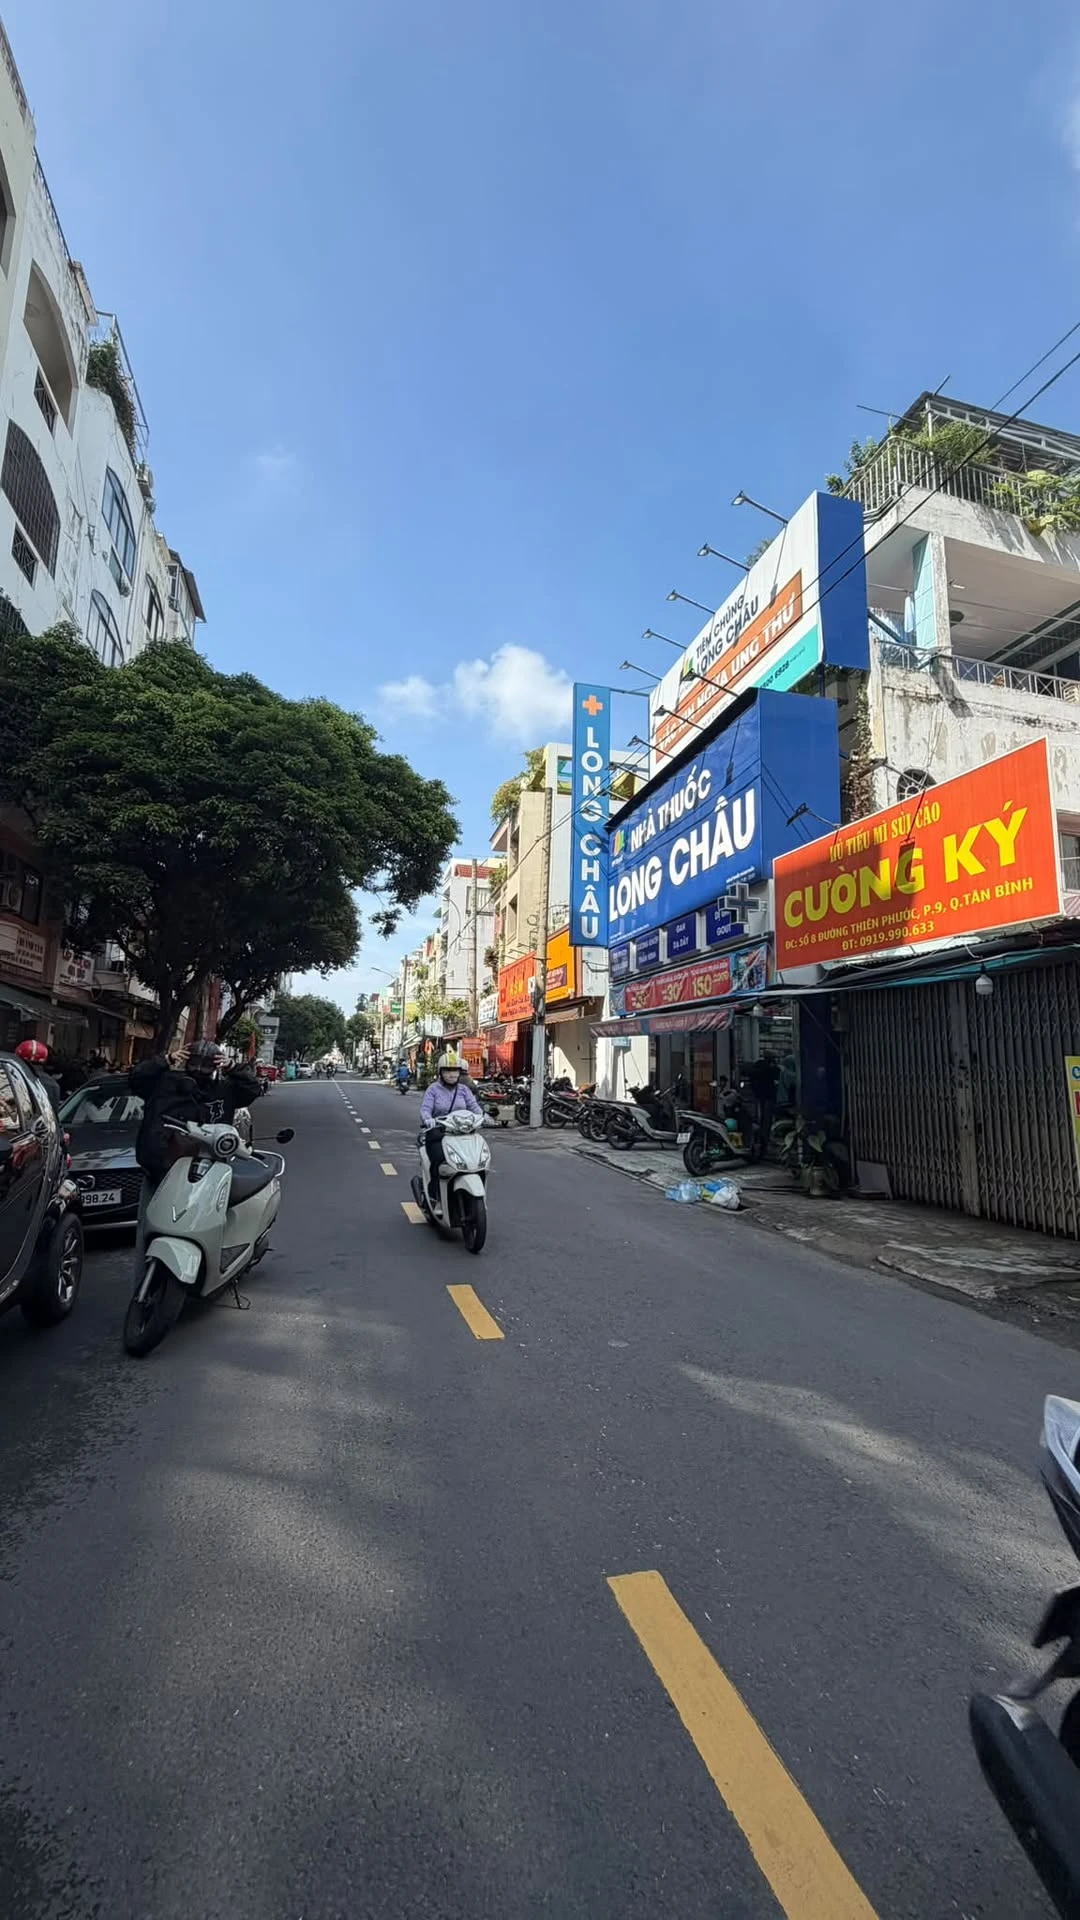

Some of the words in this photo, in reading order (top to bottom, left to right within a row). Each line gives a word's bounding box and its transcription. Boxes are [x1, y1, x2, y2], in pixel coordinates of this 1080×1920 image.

[726, 596, 759, 648] CHÂU
[580, 727, 603, 823] LONG
[631, 809, 656, 852] NHÀ
[657, 765, 711, 830] THUỐC
[609, 856, 662, 922] LONG
[669, 788, 755, 886] CHÂU
[783, 847, 926, 928] CƯỜNG
[943, 800, 1028, 883] KÝ
[846, 828, 870, 856] TIẾU
[873, 820, 888, 845] MÌ
[579, 833, 602, 939] CHÂU
[811, 934, 817, 943] 8
[818, 925, 849, 941] ĐƯỜNG
[850, 917, 879, 934] THIÊN
[881, 907, 921, 926] PHƯỚC,
[923, 901, 947, 916] P.9,
[949, 887, 991, 911] Q.TÂN
[994, 877, 1034, 898] BÌNH
[842, 940, 858, 951] ĐT:
[859, 920, 935, 947] 0919.990.633
